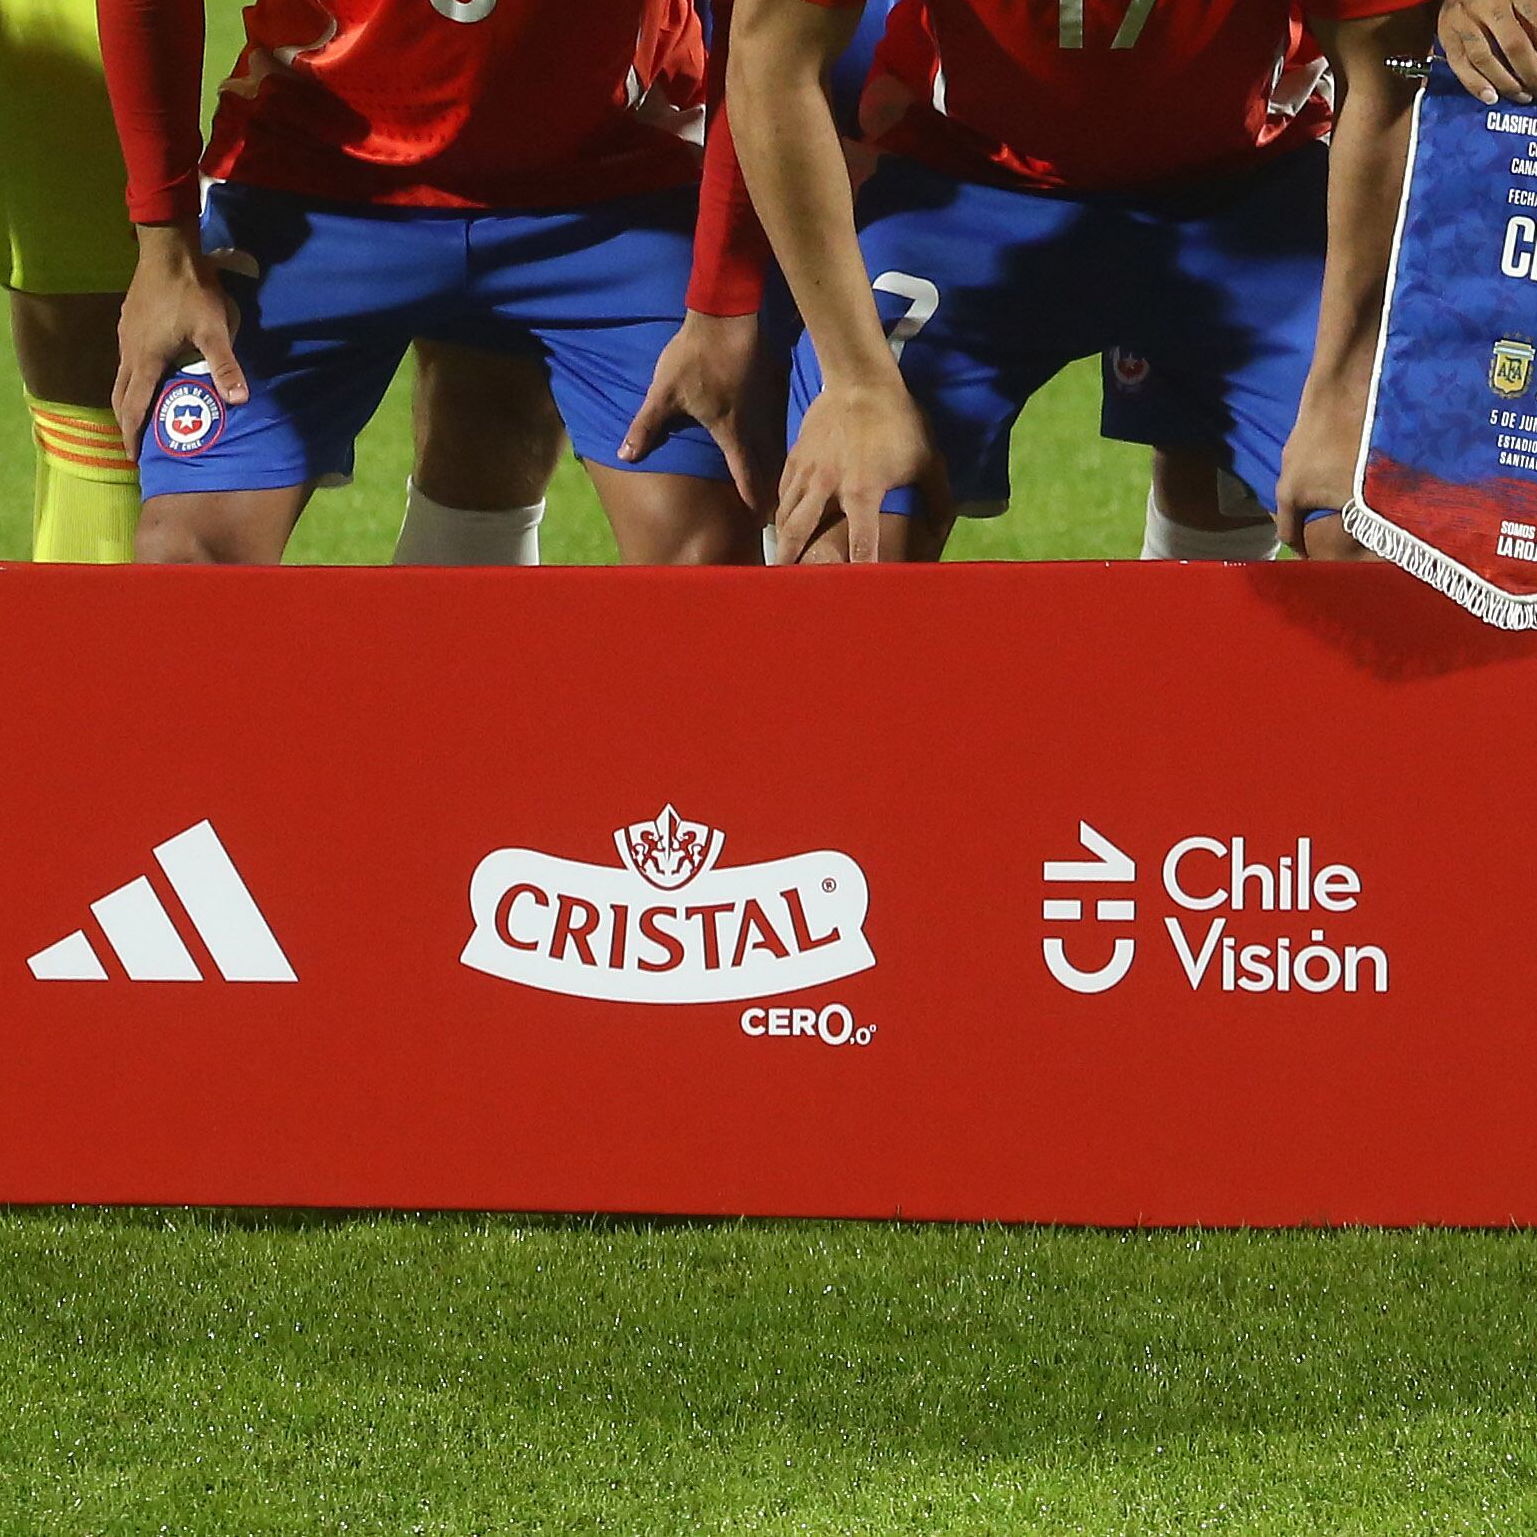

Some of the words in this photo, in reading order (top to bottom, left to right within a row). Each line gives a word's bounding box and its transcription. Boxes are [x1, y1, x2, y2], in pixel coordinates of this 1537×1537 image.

[1490, 409, 1498, 424] 5
[1501, 411, 1517, 428] DE
[1501, 520, 1536, 539] SOMOS
[1497, 535, 1515, 558] LA
[1162, 836, 1361, 912] Chile
